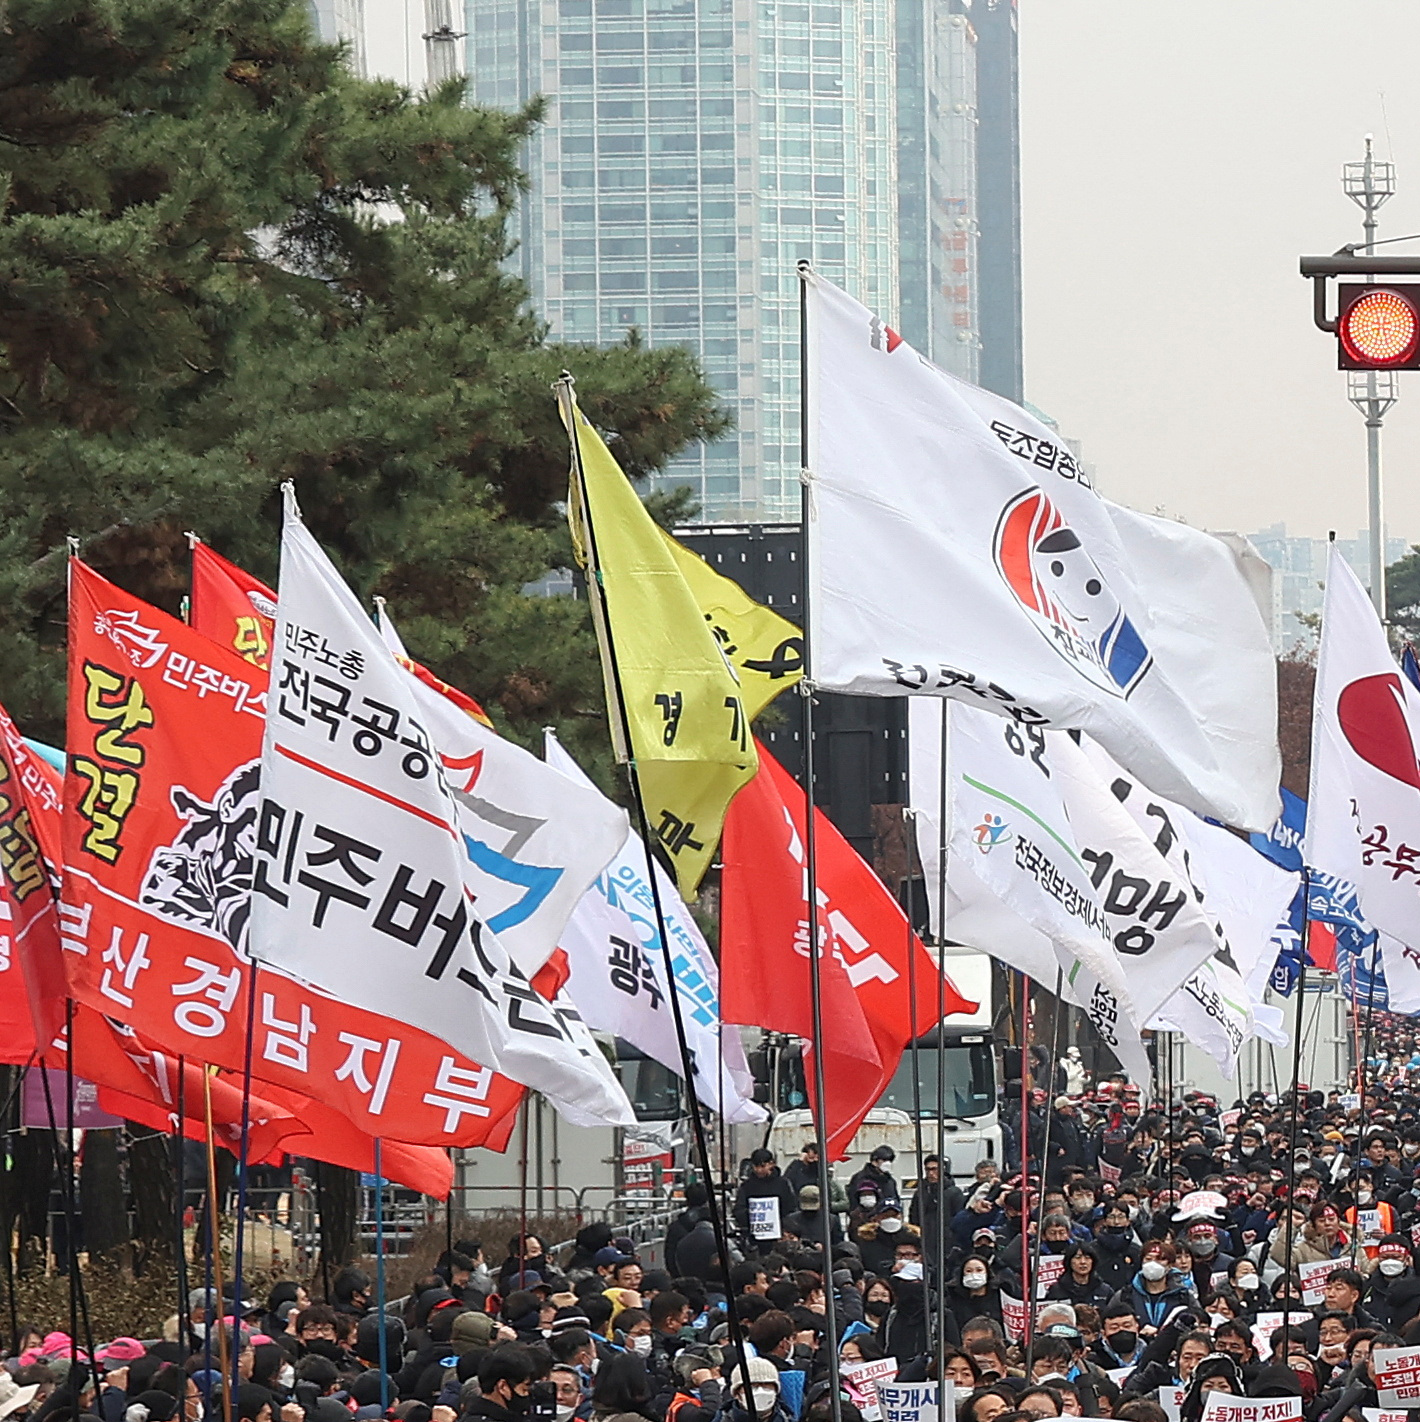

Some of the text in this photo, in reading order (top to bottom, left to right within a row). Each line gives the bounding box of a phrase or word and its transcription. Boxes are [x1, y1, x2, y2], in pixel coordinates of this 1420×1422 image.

[284, 620, 365, 679] 민주노총
[1207, 1401, 1292, 1422] 노동개악 저지!
